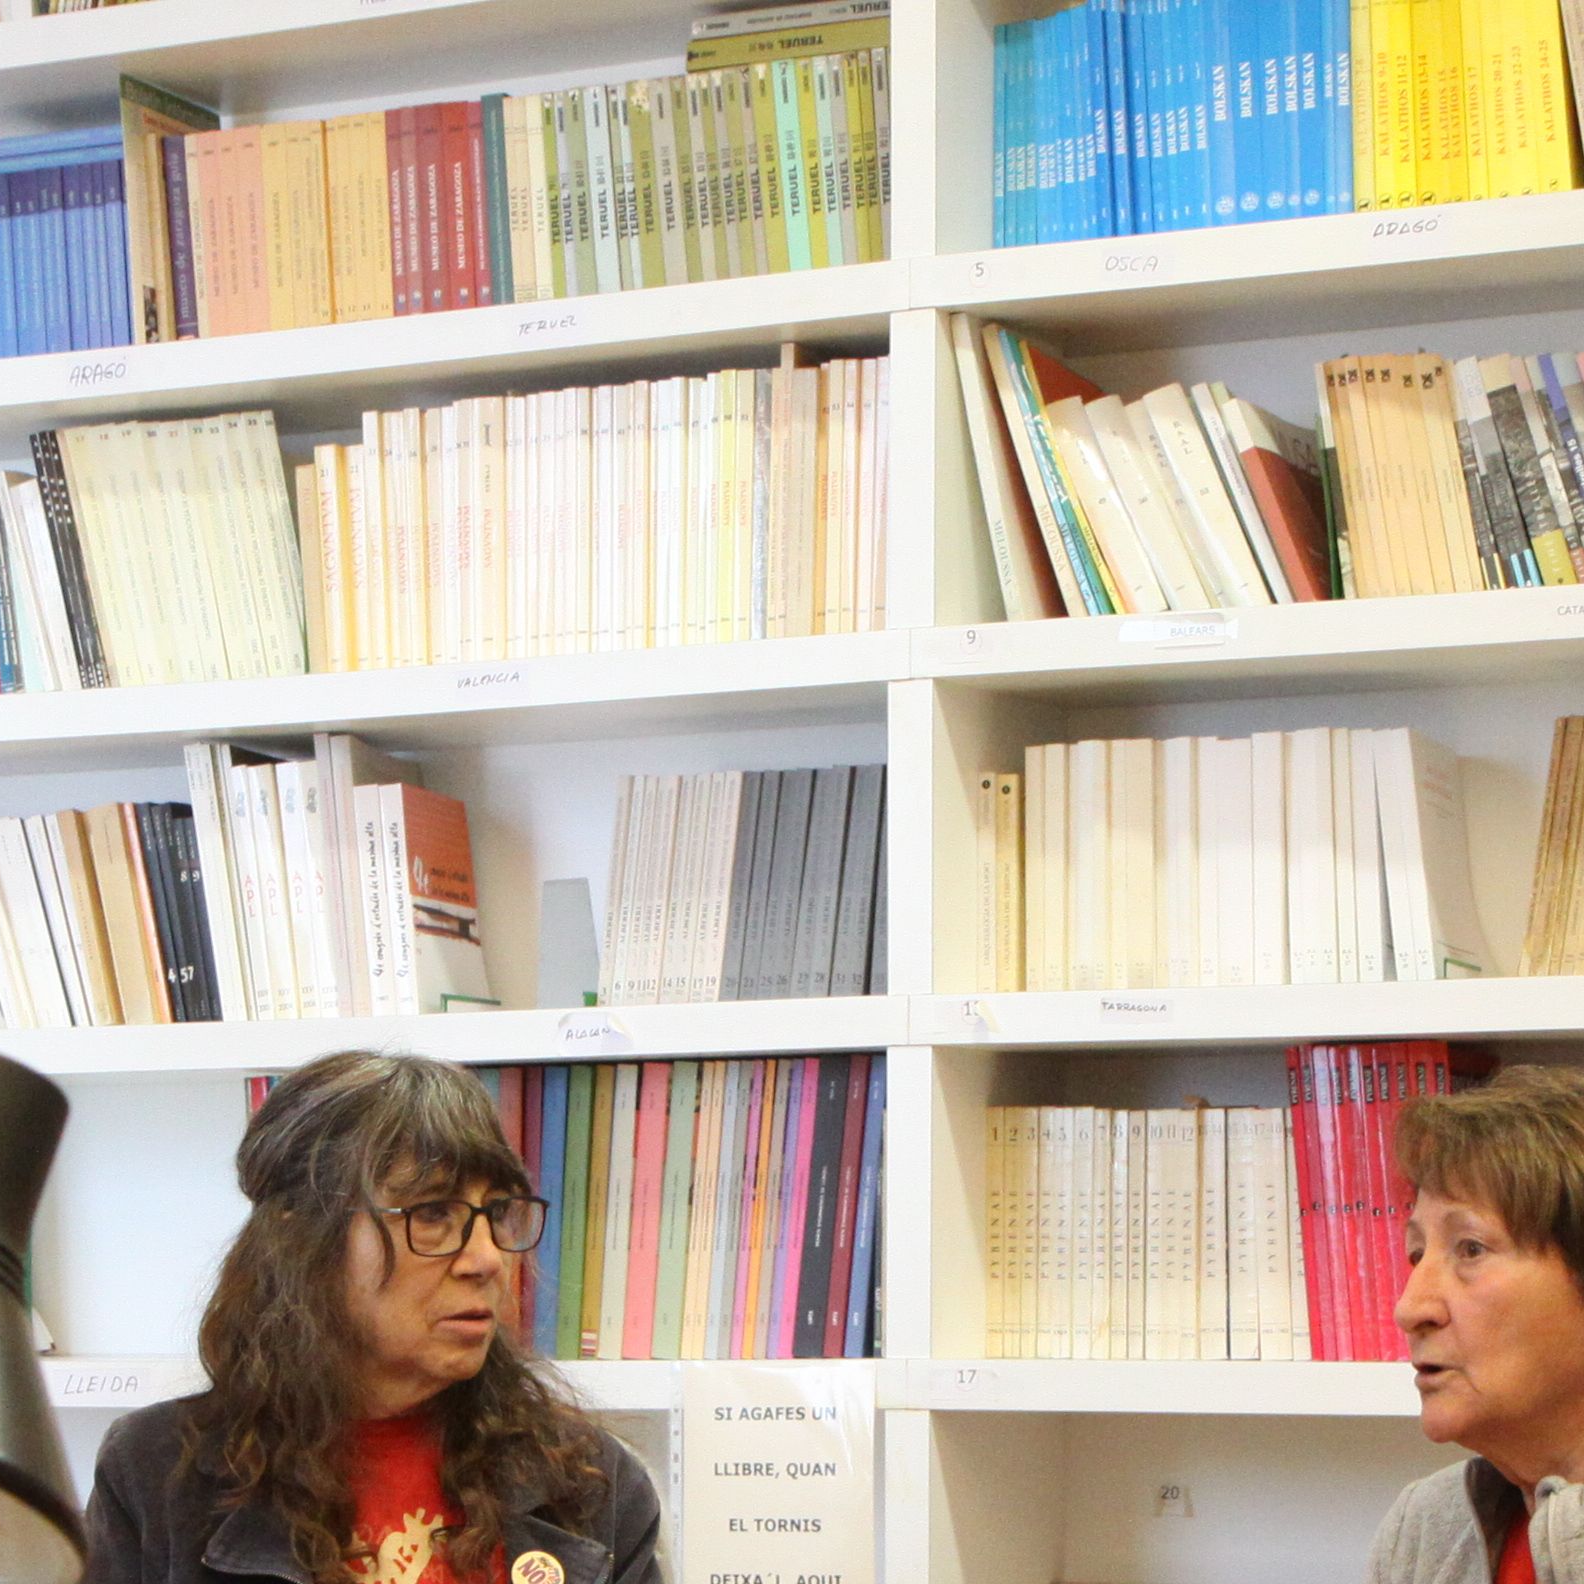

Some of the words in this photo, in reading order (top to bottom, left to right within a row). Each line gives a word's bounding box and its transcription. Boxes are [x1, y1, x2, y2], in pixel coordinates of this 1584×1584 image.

[1212, 65, 1226, 121] BOLSKAN
[1239, 62, 1252, 118] BOLSKAN
[1265, 59, 1279, 115] BOLSKAN
[1284, 56, 1298, 112] BOLSKAN
[1303, 53, 1316, 110] BOLSKAN
[1337, 53, 1349, 106] BOLSKAN
[1113, 110, 1127, 155] BOLSKAN
[1166, 110, 1178, 155] BOLSKAN
[1177, 106, 1191, 151] BOLSKAN
[1195, 105, 1207, 149] BOLSKAN
[1378, 82, 1390, 156] KALATHOS
[1398, 89, 1410, 163] KALATHOS
[1420, 89, 1432, 160] KALATHOS
[1439, 89, 1451, 160] KALATHOS
[1450, 81, 1462, 158] KALATHOS
[1468, 84, 1481, 157] KALATHOS
[1494, 84, 1506, 155] KALATHOS
[1514, 79, 1528, 149] KALATHOS
[1542, 73, 1556, 142] KALATHOS
[1134, 113, 1147, 158] BOLSKAN
[1151, 113, 1163, 158] BOLSKAN
[391, 170, 402, 220] ZARAGOZA
[407, 166, 417, 217] ZARAGOZA
[428, 164, 438, 214] ZARAGOZA
[454, 162, 464, 213] ZARAGOZA
[642, 183, 654, 233] TERUEL
[663, 181, 676, 232] TERUEL
[697, 177, 709, 228] TERUEL
[723, 174, 736, 224] TERUEL
[750, 169, 764, 220] TERUEL
[766, 167, 780, 218] TERUEL
[788, 165, 801, 216] TERUEL
[809, 163, 822, 215] TERUEL
[824, 162, 837, 213] TERUEL
[839, 160, 852, 211] TERUEL
[853, 158, 865, 210] TERUEL
[550, 195, 560, 245] TERUEL
[563, 194, 573, 244] TERUEL
[577, 192, 589, 241] TERUEL
[596, 189, 609, 240] TERUEL
[618, 189, 628, 239] TERUEL
[628, 188, 640, 237] TERUEL
[395, 241, 403, 276] MUSEO
[410, 237, 418, 272] MUSEO
[431, 235, 440, 271] MUSEO
[457, 233, 466, 269] MUSEO
[974, 262, 985, 278] 5
[1104, 255, 1160, 274] OSCA
[966, 630, 976, 645] 9
[1169, 626, 1217, 638] BALEARS
[64, 1374, 138, 1395] LLEIDA
[958, 1370, 977, 1384] 17
[714, 1407, 733, 1421] SI
[739, 1407, 806, 1421] AGAFES
[812, 1406, 837, 1420] UN
[714, 1462, 781, 1479] LLIBRE,
[786, 1462, 837, 1480] QUAN
[1160, 1485, 1180, 1500] 20
[729, 1518, 748, 1532] EL
[754, 1518, 822, 1532] TORNIS
